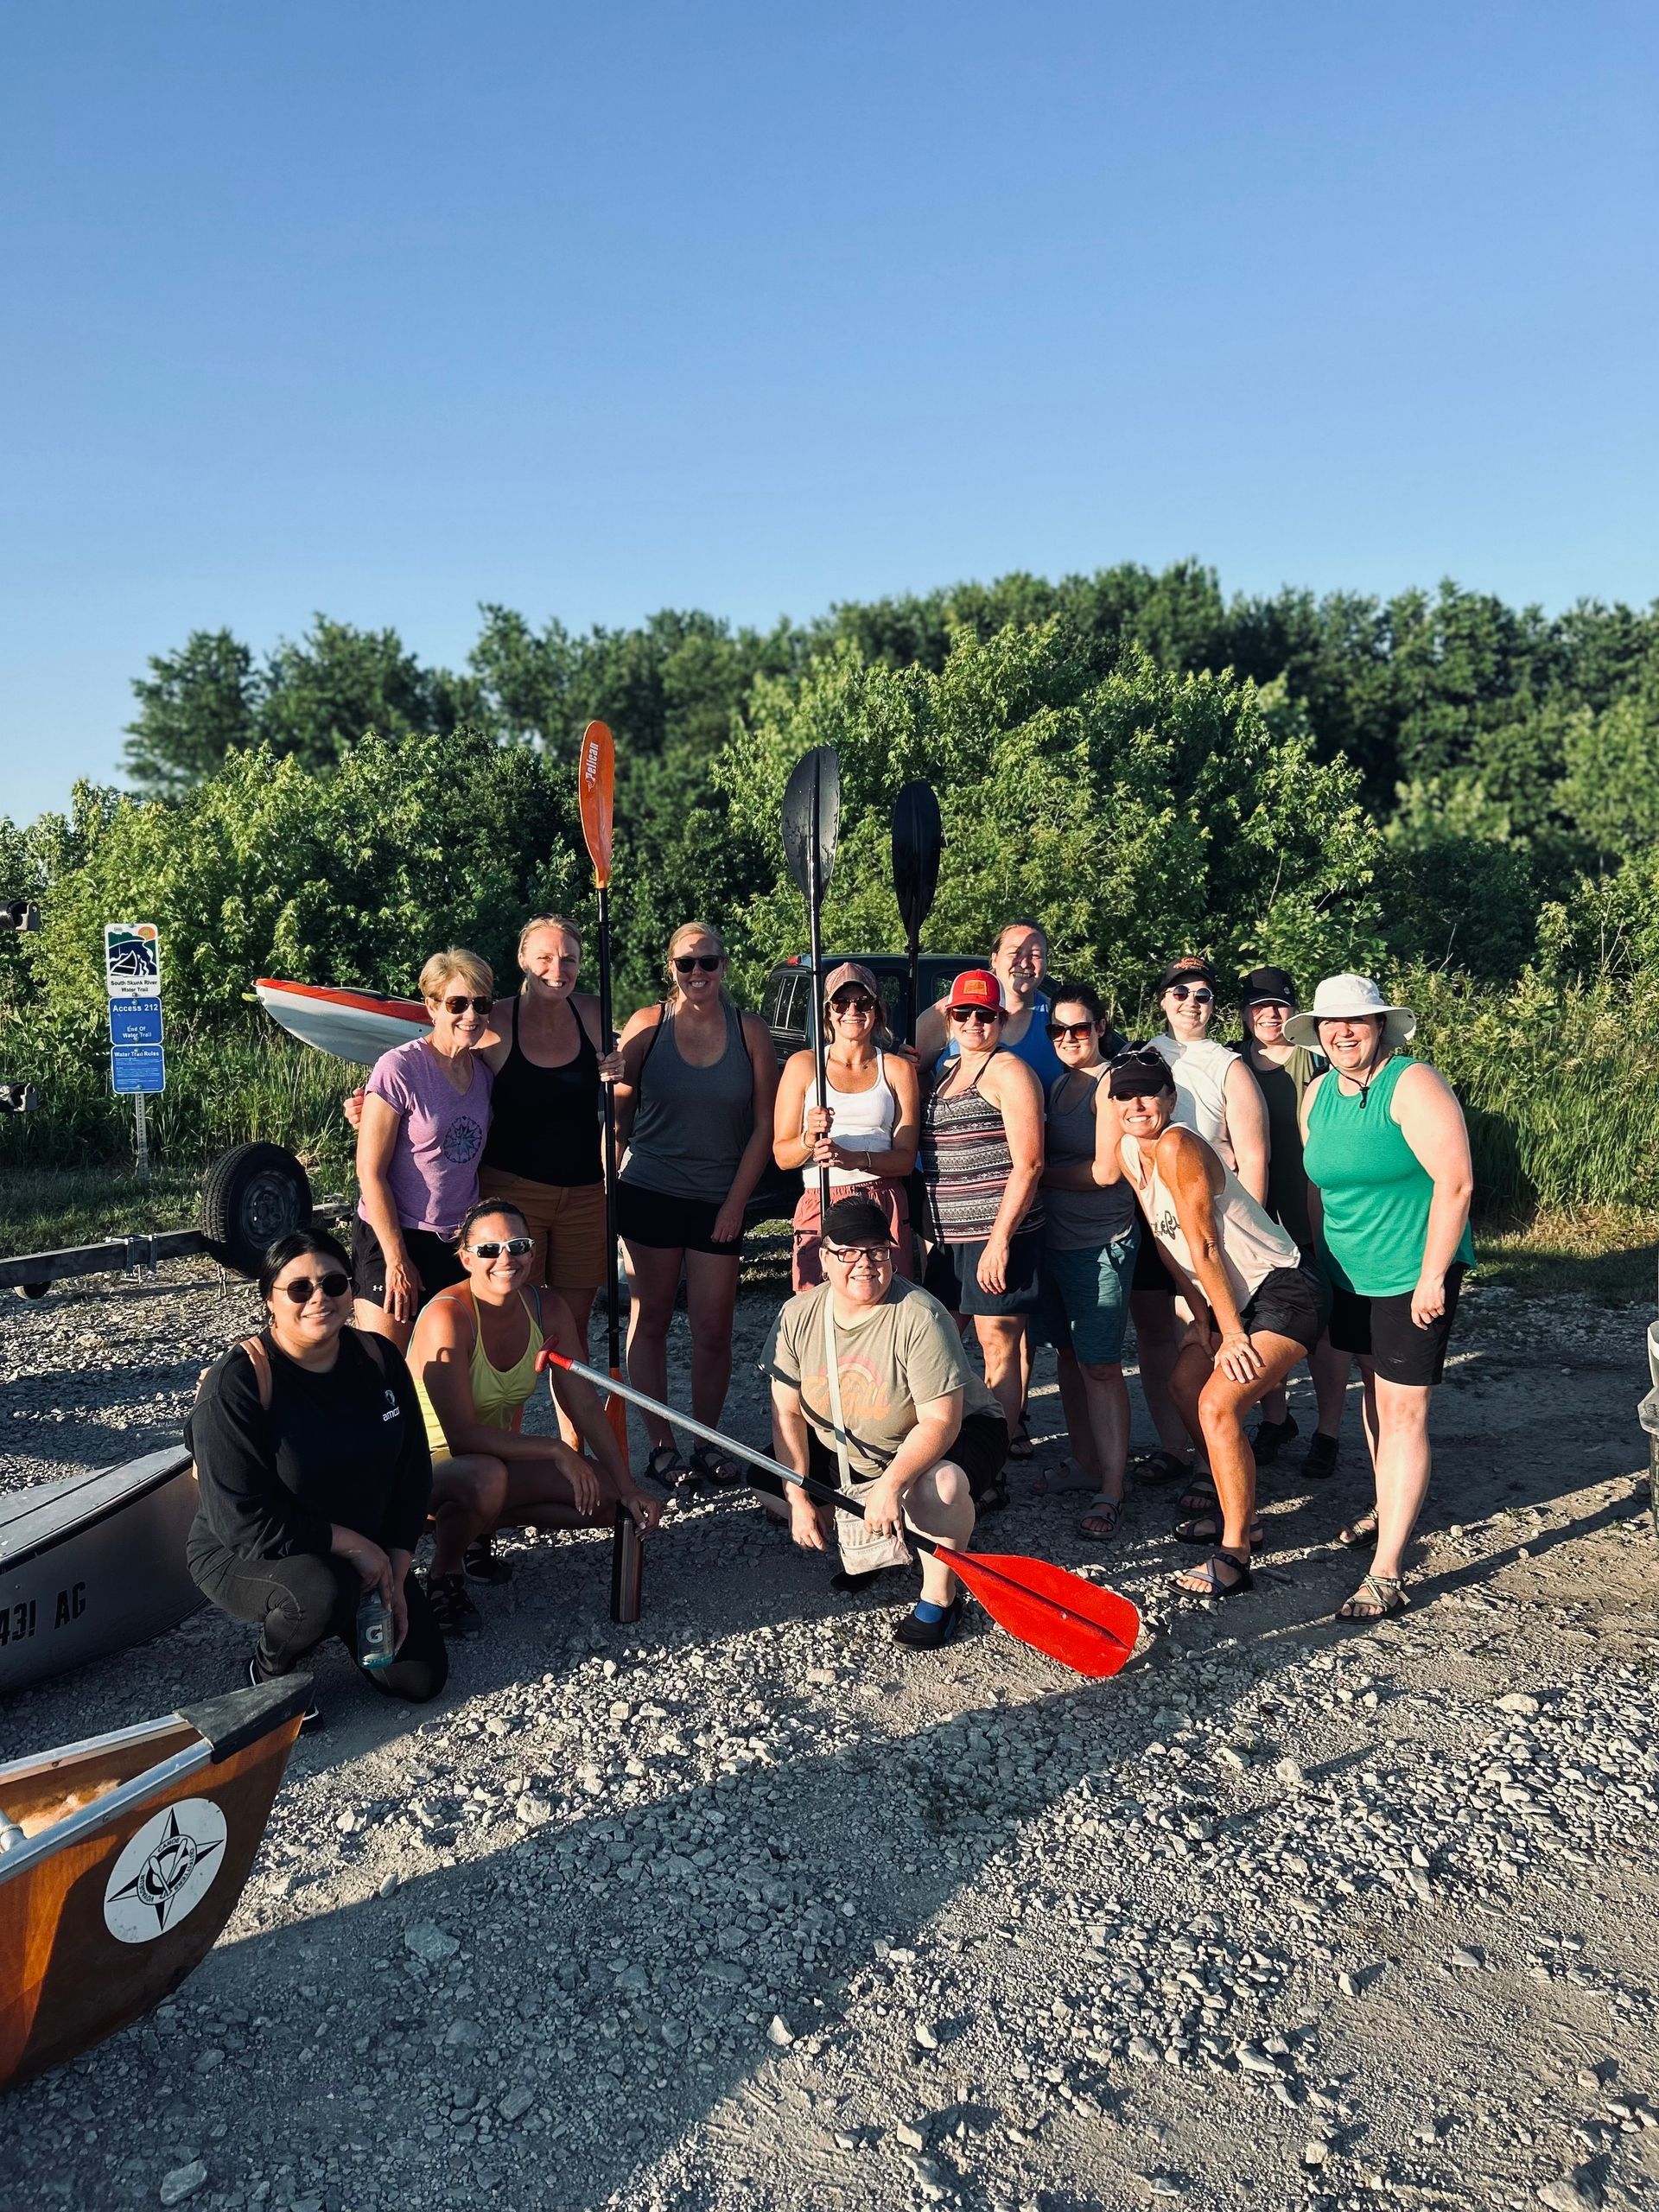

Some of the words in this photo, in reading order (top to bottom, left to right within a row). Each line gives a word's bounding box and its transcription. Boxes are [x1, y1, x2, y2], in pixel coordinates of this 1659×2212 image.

[585, 741, 600, 781] Pelican
[54, 1581, 86, 1630] AG
[366, 1624, 383, 1643] G
[157, 1837, 181, 1853] CANOE
[174, 1847, 195, 1891] OUTFITTERS
